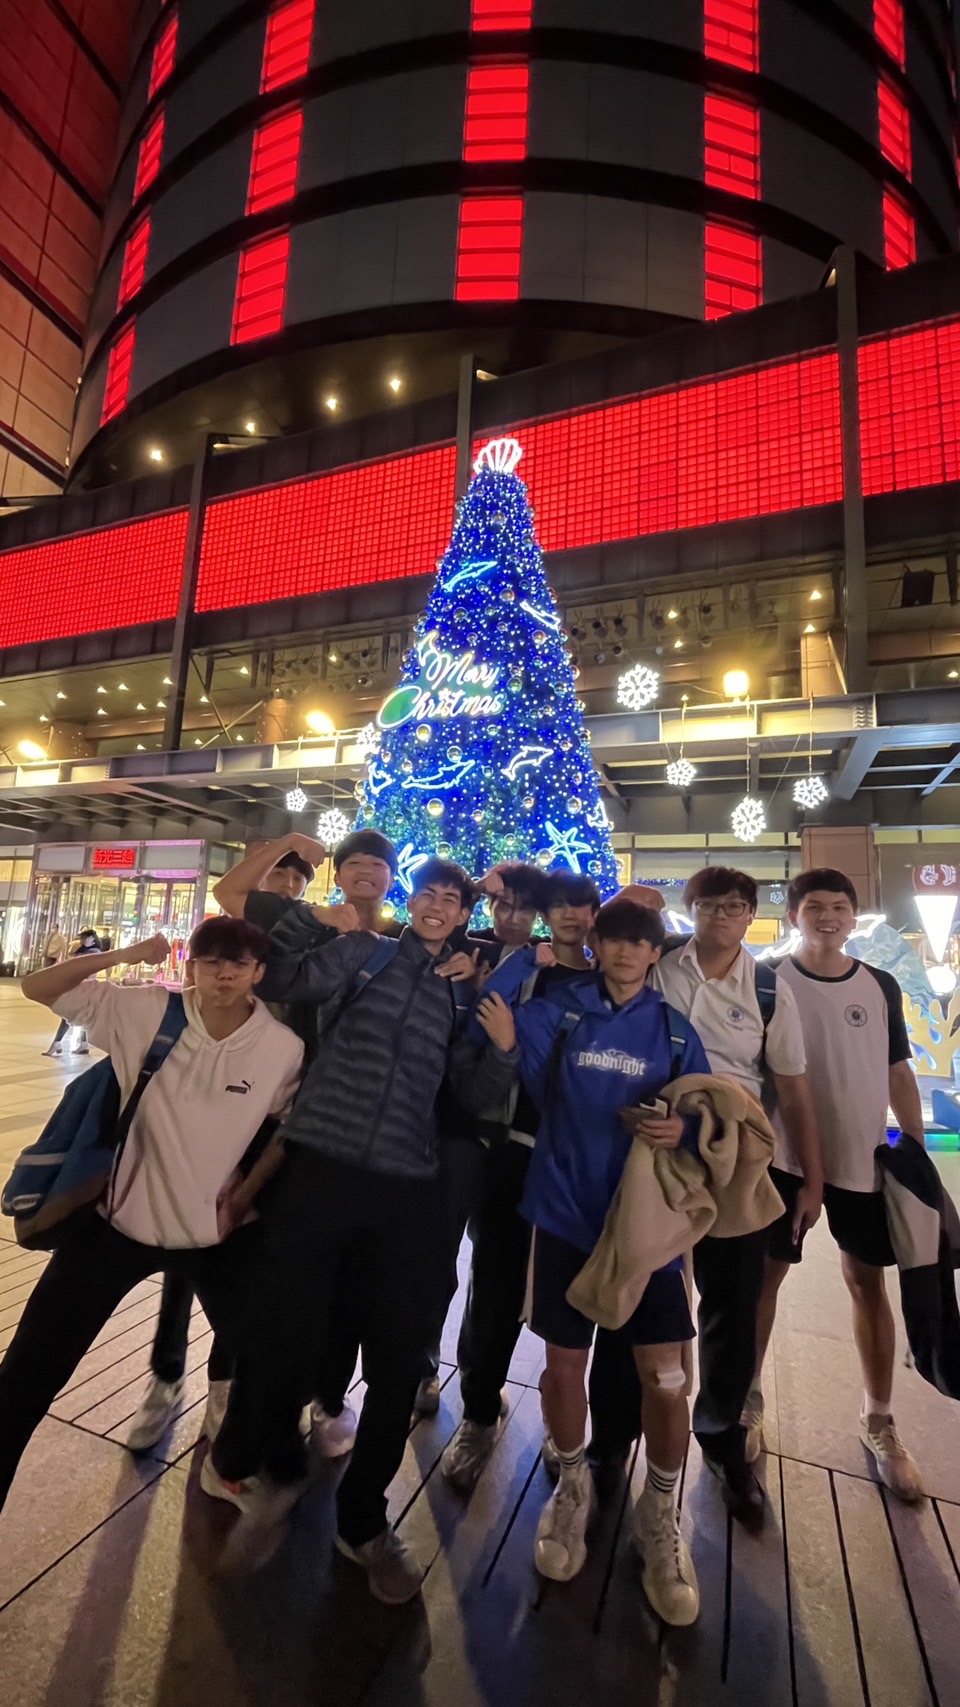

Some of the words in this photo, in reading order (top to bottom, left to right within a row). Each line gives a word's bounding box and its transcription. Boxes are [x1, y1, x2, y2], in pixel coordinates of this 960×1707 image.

[377, 686, 504, 728] Christmas
[94, 849, 135, 863] 新光三越
[577, 1050, 646, 1076] goodnight
